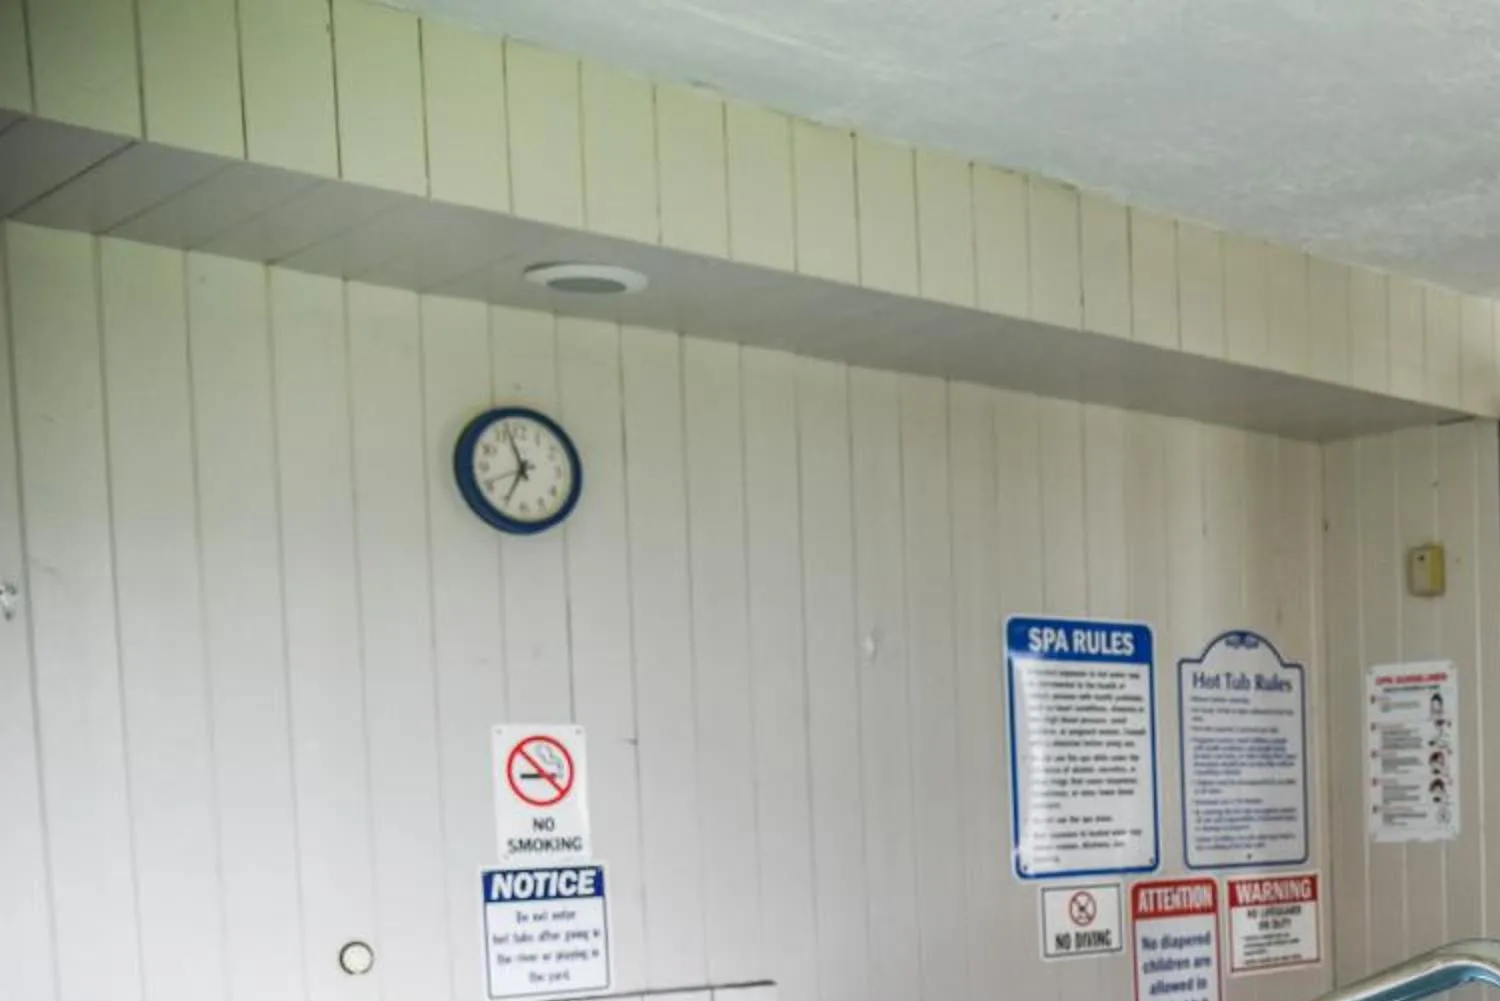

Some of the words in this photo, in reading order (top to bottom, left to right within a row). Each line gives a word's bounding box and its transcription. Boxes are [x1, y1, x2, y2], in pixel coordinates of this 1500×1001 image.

[1027, 626, 1070, 653] SPA
[1072, 628, 1135, 657] RULES
[1192, 672, 1221, 689] Hot
[1224, 672, 1251, 691] Tub
[1254, 673, 1293, 693] Rules
[532, 817, 555, 832] NO
[506, 836, 583, 854] SMOKING
[491, 869, 597, 900] NOTICE
[1236, 878, 1312, 904] WARNING
[1139, 885, 1213, 912] ATTENTION
[1055, 932, 1072, 950] NO
[1075, 929, 1112, 949] DIVING
[1161, 932, 1212, 949] diapered
[1143, 959, 1190, 974] children
[1194, 956, 1212, 967] are
[1149, 978, 1193, 995] allowed
